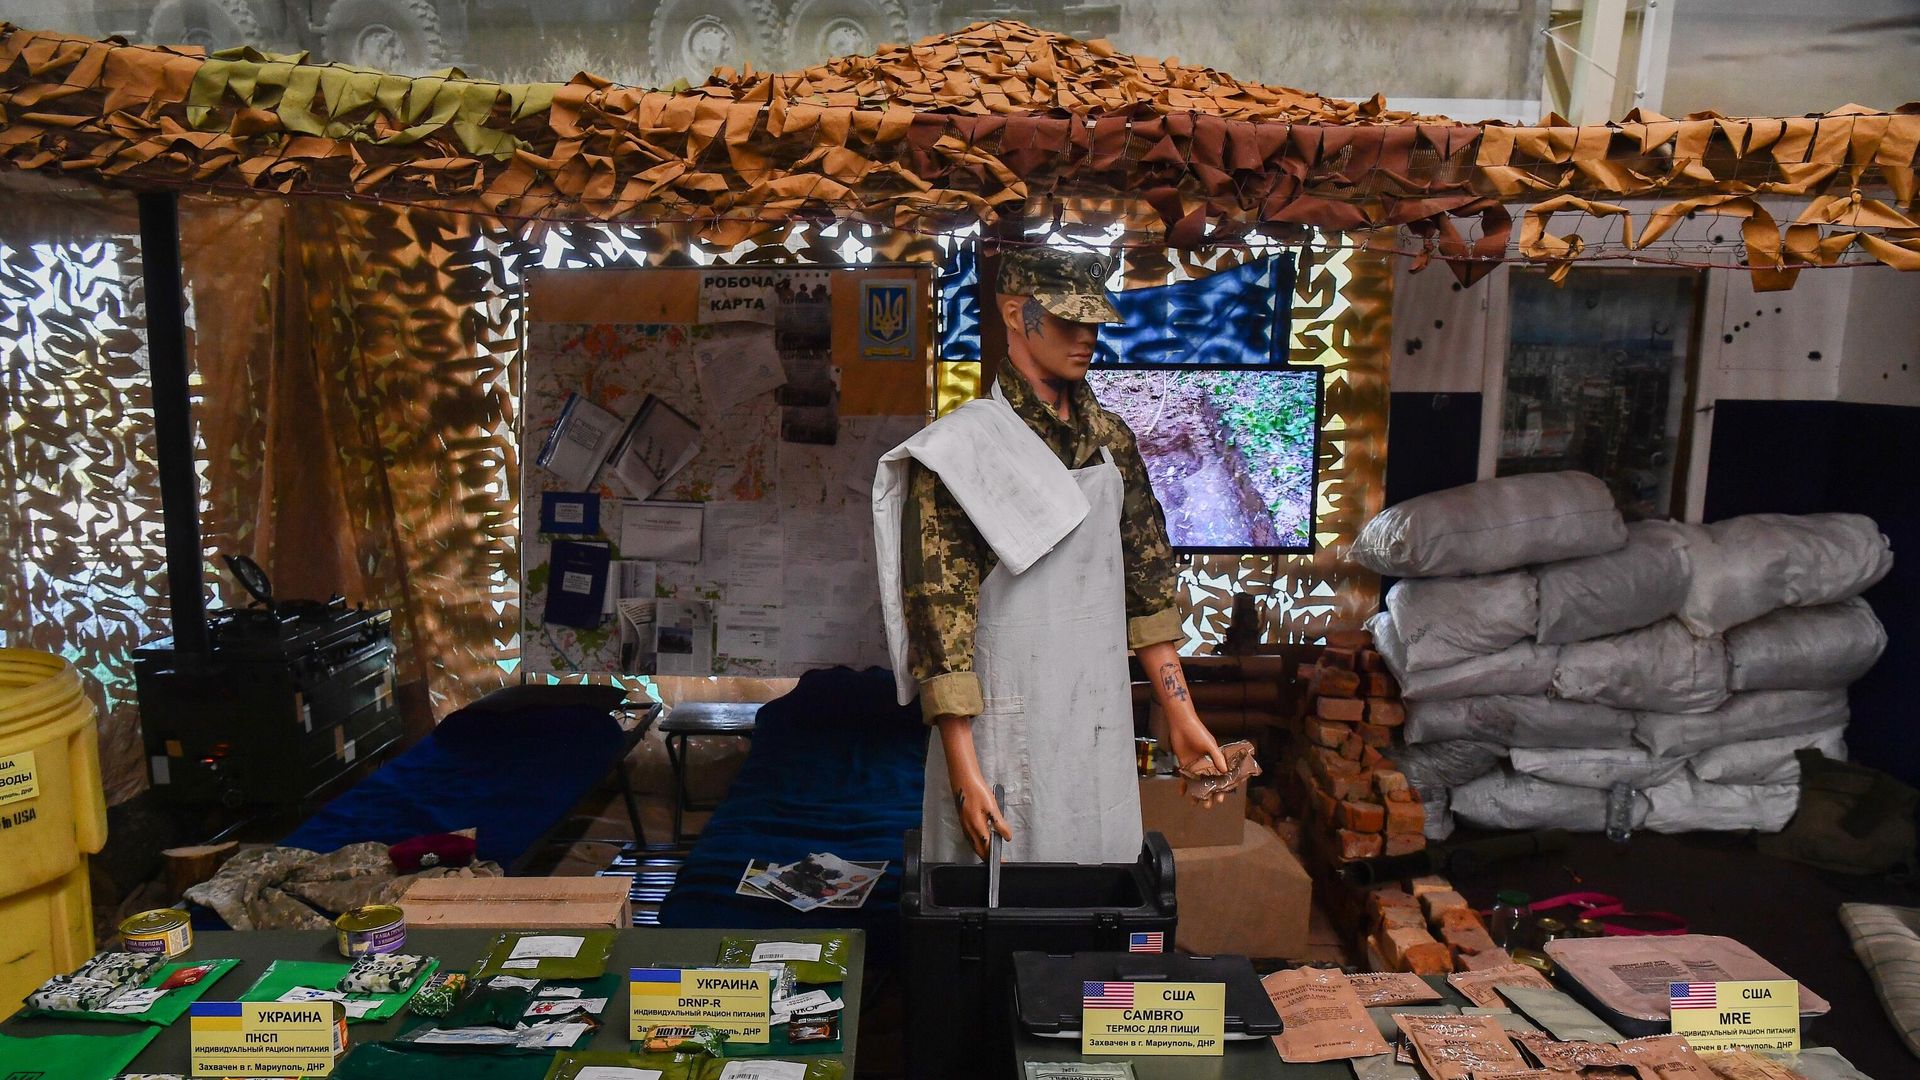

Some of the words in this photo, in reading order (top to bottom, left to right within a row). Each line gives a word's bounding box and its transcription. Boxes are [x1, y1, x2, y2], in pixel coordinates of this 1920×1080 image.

[704, 276, 774, 290] РОБОЧА
[710, 297, 765, 311] КАРТА
[0, 761, 15, 770] ША
[2, 816, 12, 829] in
[13, 807, 37, 825] USA
[696, 978, 759, 990] УКРАИНА
[1162, 990, 1196, 1001] США
[1742, 989, 1772, 999] США
[678, 998, 721, 1008] DRNP-R
[258, 1011, 322, 1023] УКРАИНА
[634, 1008, 701, 1017] ИНДИВИДУАЛЬНЫЙ
[1123, 1009, 1184, 1021] CAMBRO
[1719, 1012, 1752, 1025] MRE
[743, 1028, 761, 1036] ДНР
[1106, 1024, 1146, 1033] ТЕРМОС
[1147, 1025, 1167, 1034] ДЛЯ
[1170, 1025, 1200, 1034] ПИЩИ
[1766, 1027, 1796, 1035] ПИТАНИЯ
[245, 1033, 278, 1043] ПНСП
[1089, 1039, 1129, 1047] Захвачен
[1145, 1039, 1195, 1048] Мариуполь,
[1197, 1039, 1216, 1048] ДНР
[1777, 1041, 1793, 1049] ДНР
[195, 1045, 263, 1054] ИНДИВИДУАЛЬНЫЙ
[265, 1046, 295, 1054] РАЦИОН
[198, 1063, 238, 1071] Захвачен
[254, 1063, 305, 1072] Мариуполь,
[306, 1063, 325, 1071] ДНР
